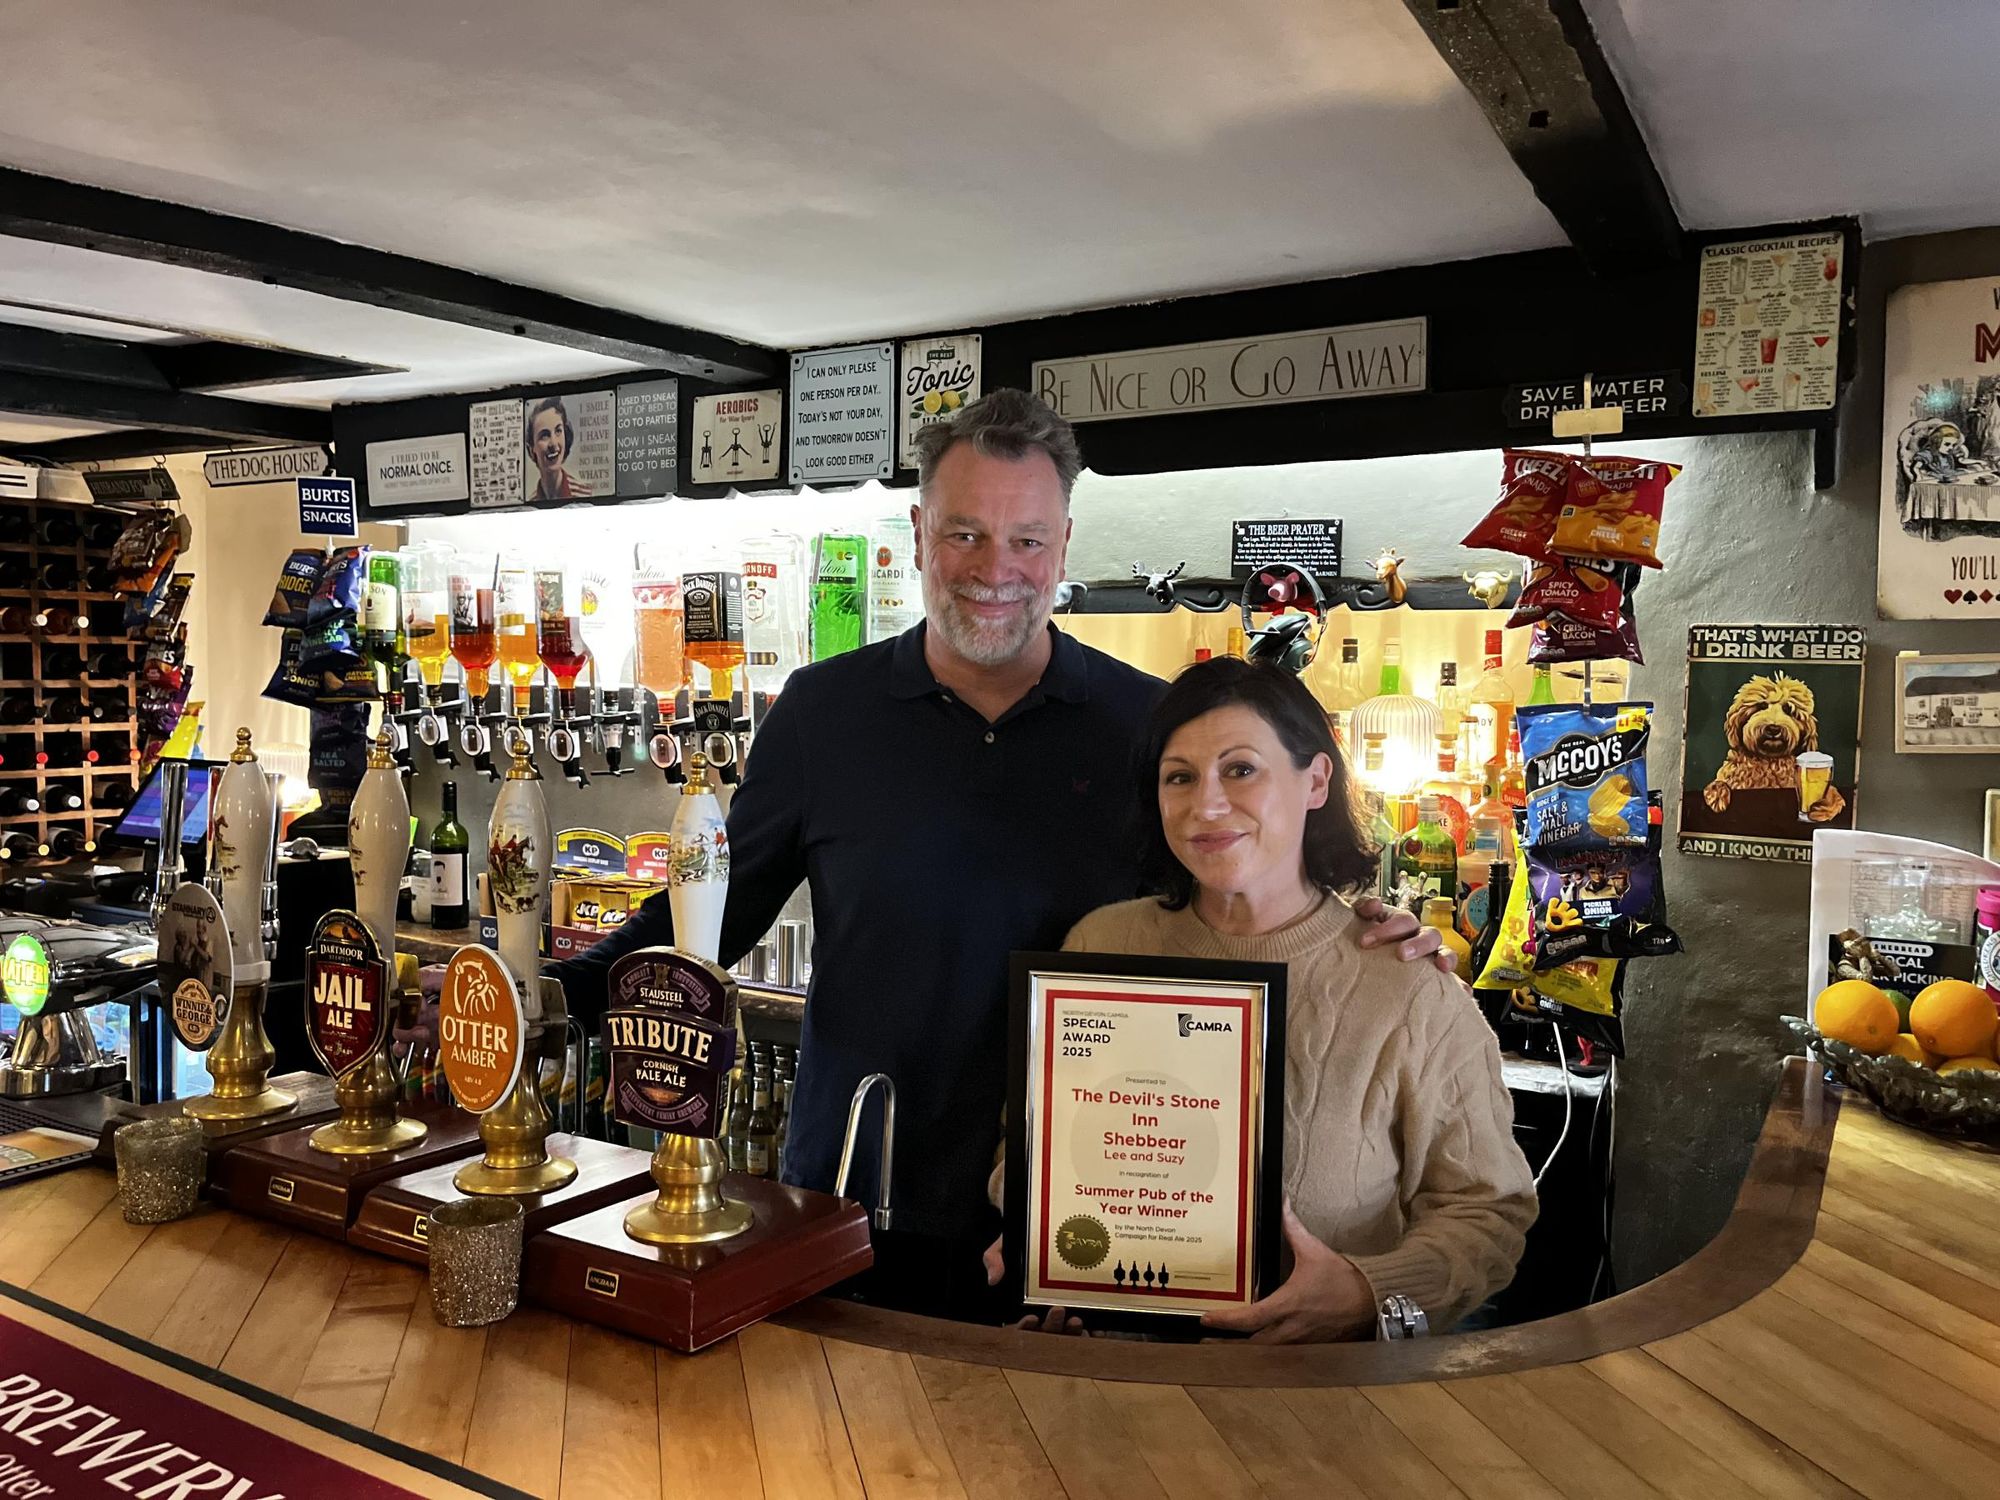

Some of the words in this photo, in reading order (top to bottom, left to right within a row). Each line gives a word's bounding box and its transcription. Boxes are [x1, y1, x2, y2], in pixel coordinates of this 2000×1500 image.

[1705, 245, 1748, 257] CLASSIC
[1748, 240, 1796, 252] COCKTAIL
[1797, 236, 1839, 248] RECIPES
[811, 367, 826, 379] CAN
[828, 365, 847, 377] ONLY
[849, 361, 877, 374] PLEASE
[906, 360, 975, 397] Tonic
[800, 391, 815, 402] ONE
[817, 388, 845, 400] PERSON
[847, 386, 860, 397] PER
[1521, 385, 1576, 403] SAVE
[1591, 378, 1665, 398] WATER
[586, 400, 610, 412] SMILE
[621, 396, 640, 406] USED
[641, 395, 651, 404] TO
[652, 392, 676, 402] SNEAK
[618, 406, 633, 416] OUT
[635, 404, 646, 414] OF
[648, 403, 663, 413] BED
[666, 401, 676, 410] TO
[716, 397, 759, 416] AEROBICS
[580, 414, 610, 428] BECAUSE
[618, 419, 630, 429] GO
[632, 417, 644, 427] TO
[645, 414, 677, 426] PARTIES
[798, 411, 827, 424] TODAY'S
[829, 410, 843, 422] NOT
[846, 409, 865, 420] YOUR
[867, 408, 883, 419] DAY,
[587, 430, 610, 441] HAVE
[617, 436, 640, 448] NOW
[647, 433, 676, 445] SNEAK
[795, 437, 810, 447] AND
[812, 433, 854, 445] TOMORROW
[855, 428, 887, 442] DOESN'T
[618, 450, 632, 460] OUT
[635, 449, 646, 458] OF
[648, 446, 677, 457] PARTIES
[212, 459, 240, 479] THE
[240, 456, 271, 478] DOG
[272, 451, 320, 474] HOUSE
[579, 457, 591, 466] NO
[593, 456, 610, 464] IDEA
[618, 463, 629, 472] TO
[631, 461, 644, 472] GO
[646, 460, 658, 470] TO
[660, 459, 677, 468] BED
[805, 458, 825, 468] LOOK
[826, 456, 847, 466] GOOD
[849, 453, 874, 465] EITHER
[380, 463, 421, 480] NORMAL
[423, 460, 455, 476] ONCE.
[301, 488, 350, 503] BURTS
[303, 511, 352, 524] SNACKS
[1248, 525, 1266, 535] THE
[1267, 525, 1289, 535] BEER
[1290, 524, 1325, 535] PRAYER
[1590, 529, 1621, 541] CHEESE
[1952, 556, 1998, 581] YOU'LL
[1548, 581, 1574, 589] SPICY
[1540, 589, 1580, 597] TOMATO
[1562, 630, 1596, 639] BACON
[1693, 629, 1757, 643] THAT'S
[1762, 629, 1820, 643] WHAT
[1823, 630, 1829, 643] I
[1833, 631, 1863, 643] DO
[1693, 644, 1699, 657] I
[1706, 643, 1785, 658] DRINK
[1792, 644, 1860, 659] BEER
[694, 704, 708, 718] JACK
[1572, 739, 1585, 747] REAL
[320, 751, 338, 759] SEA
[314, 759, 346, 767] SALTED
[1537, 805, 1557, 822] SALT
[1561, 801, 1568, 813] &
[1542, 813, 1566, 832] MALT
[1537, 821, 1582, 847] VINEGAR
[584, 845, 598, 854] KP
[654, 850, 667, 858] KP
[1682, 839, 1717, 853] AND
[1720, 841, 1725, 853] I
[1728, 843, 1780, 859] KNOW
[172, 903, 205, 916] STANNARY
[577, 902, 599, 916] KP
[1583, 900, 1611, 908] PICKLED
[1584, 907, 1612, 915] ONION
[602, 911, 626, 922] KP
[484, 929, 496, 937] KP
[557, 938, 570, 947] KP
[320, 944, 363, 961] DARTMOOR
[1884, 955, 1925, 969] OCAL
[314, 971, 371, 1012] JAIL
[649, 988, 684, 1003] AUSTELL
[176, 1008, 211, 1025] GEORGE
[326, 1009, 353, 1030] ALE
[1063, 1018, 1116, 1030] SPECIAL
[1186, 1020, 1232, 1032] CAMRA
[442, 1015, 508, 1053] OTTER
[607, 1016, 713, 1063] TRIBUTE
[1062, 1032, 1111, 1044] AWARD
[451, 1045, 496, 1069] AMBER
[1062, 1046, 1092, 1057] 2025
[642, 1060, 679, 1073] CORNISH
[636, 1068, 661, 1082] PALE
[663, 1074, 687, 1088] ALE
[1125, 1076, 1158, 1085] Presented
[1072, 1088, 1103, 1103] The
[1109, 1090, 1165, 1107] Devil's
[1171, 1094, 1221, 1110] Stone
[1132, 1112, 1158, 1127] Inn
[1104, 1132, 1187, 1149] Shebbear
[1104, 1150, 1127, 1160] Lee
[1130, 1152, 1153, 1162] and
[1156, 1152, 1185, 1165] Suzy
[1126, 1170, 1161, 1179] recognition
[1075, 1184, 1135, 1199] Summer
[1139, 1188, 1167, 1201] Pub
[1171, 1189, 1186, 1202] of
[1190, 1191, 1214, 1204] the
[1100, 1202, 1133, 1216] Year
[1137, 1204, 1188, 1219] Winner
[1114, 1232, 1147, 1241] Campaign
[1158, 1234, 1174, 1242] Real
[1186, 1236, 1202, 1244] 2025
